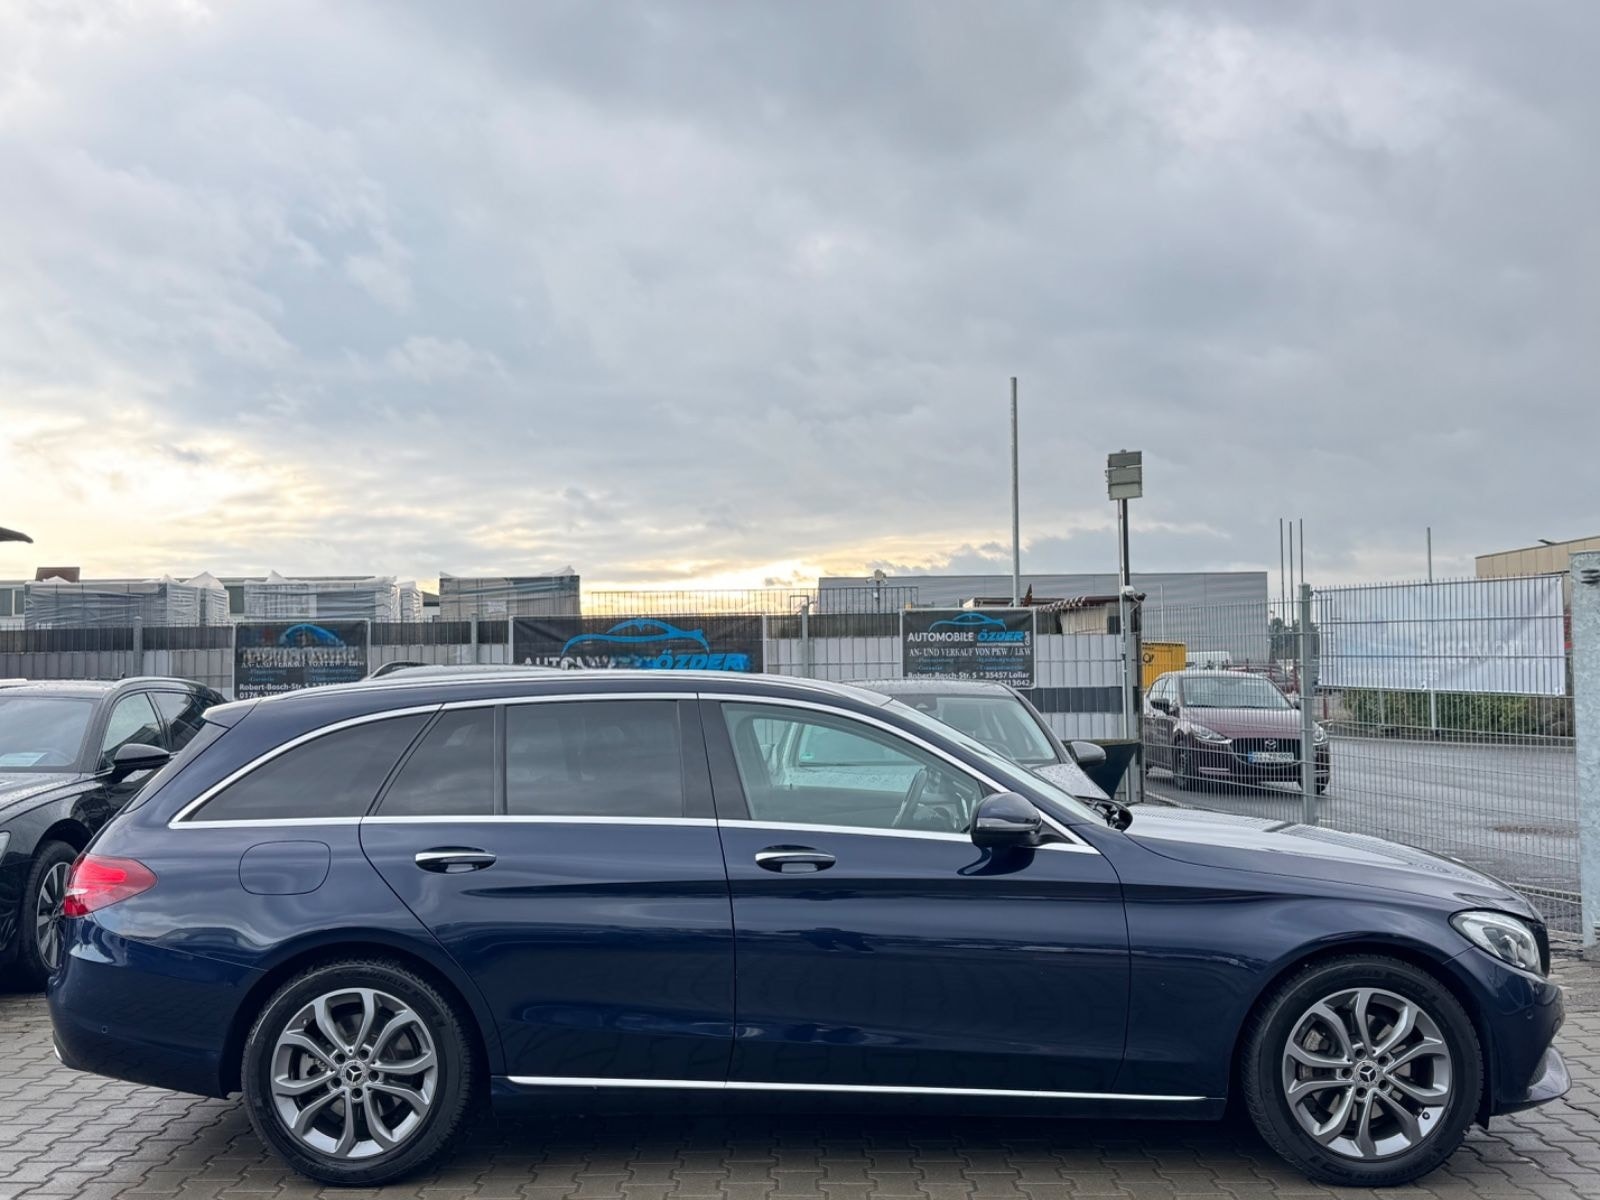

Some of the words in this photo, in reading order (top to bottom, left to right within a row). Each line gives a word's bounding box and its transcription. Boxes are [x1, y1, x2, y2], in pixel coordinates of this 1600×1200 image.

[907, 632, 974, 642] AUTOMOBILE
[977, 628, 1025, 642] ÖZDER
[924, 647, 939, 656] UND
[941, 647, 973, 656] VERKAUF
[975, 647, 990, 656] VON
[991, 647, 1007, 656] PKW
[1015, 647, 1031, 656] LKW
[655, 649, 750, 671] ÖZDER
[984, 671, 1008, 679] 35457
[1008, 671, 1030, 679] Lollar
